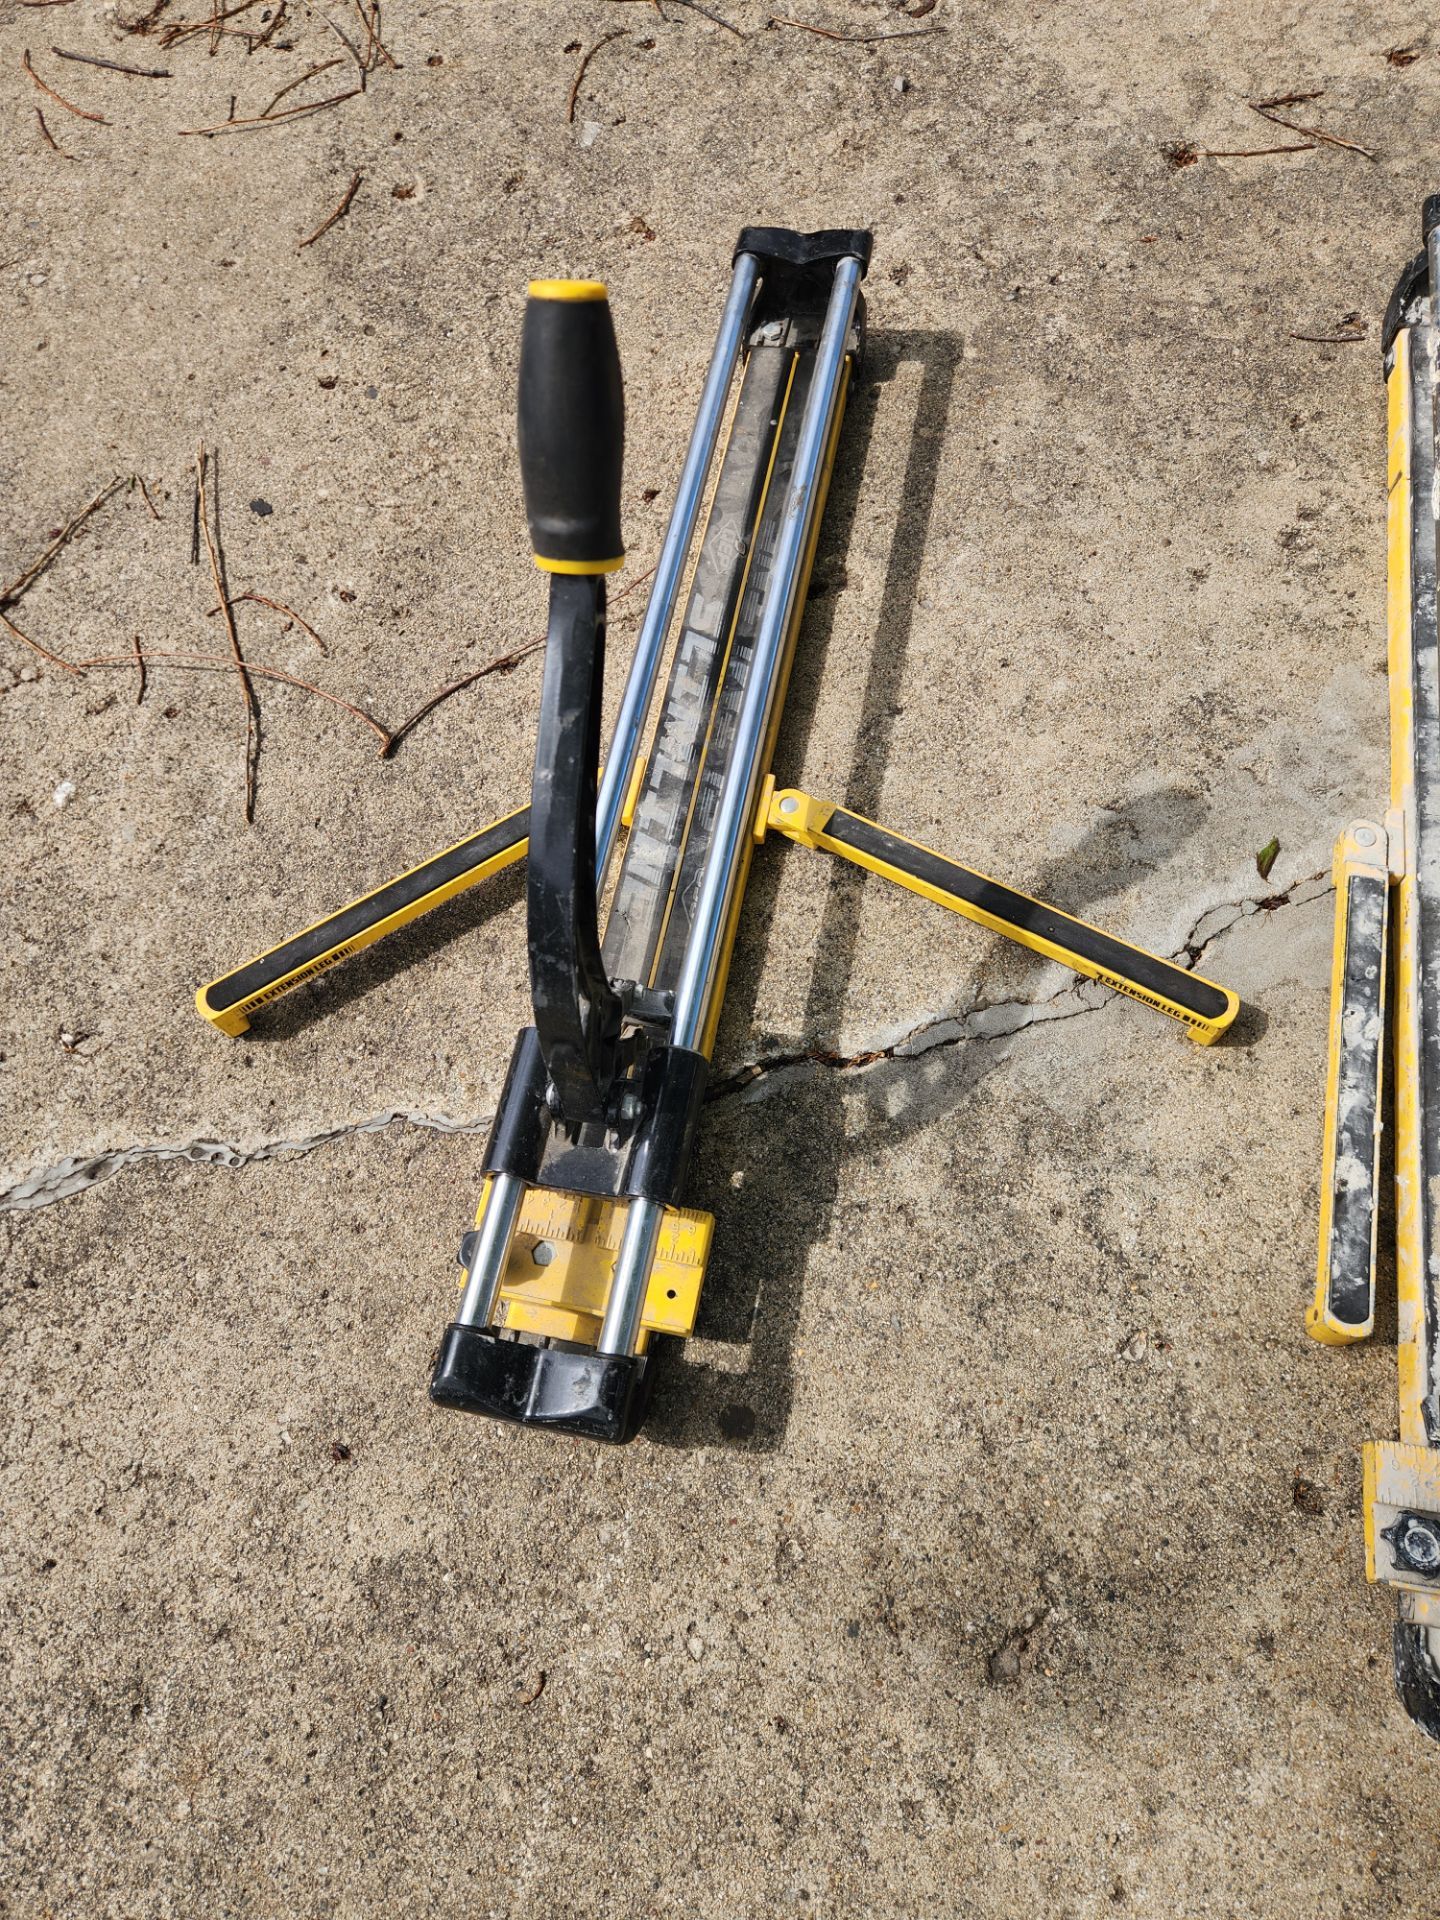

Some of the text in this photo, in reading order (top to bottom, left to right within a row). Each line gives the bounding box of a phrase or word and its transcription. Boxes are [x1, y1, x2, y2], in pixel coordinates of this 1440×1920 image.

[263, 959, 333, 1000] EXTENSION LEG
[1105, 976, 1181, 1018] EXTENSION LEG
